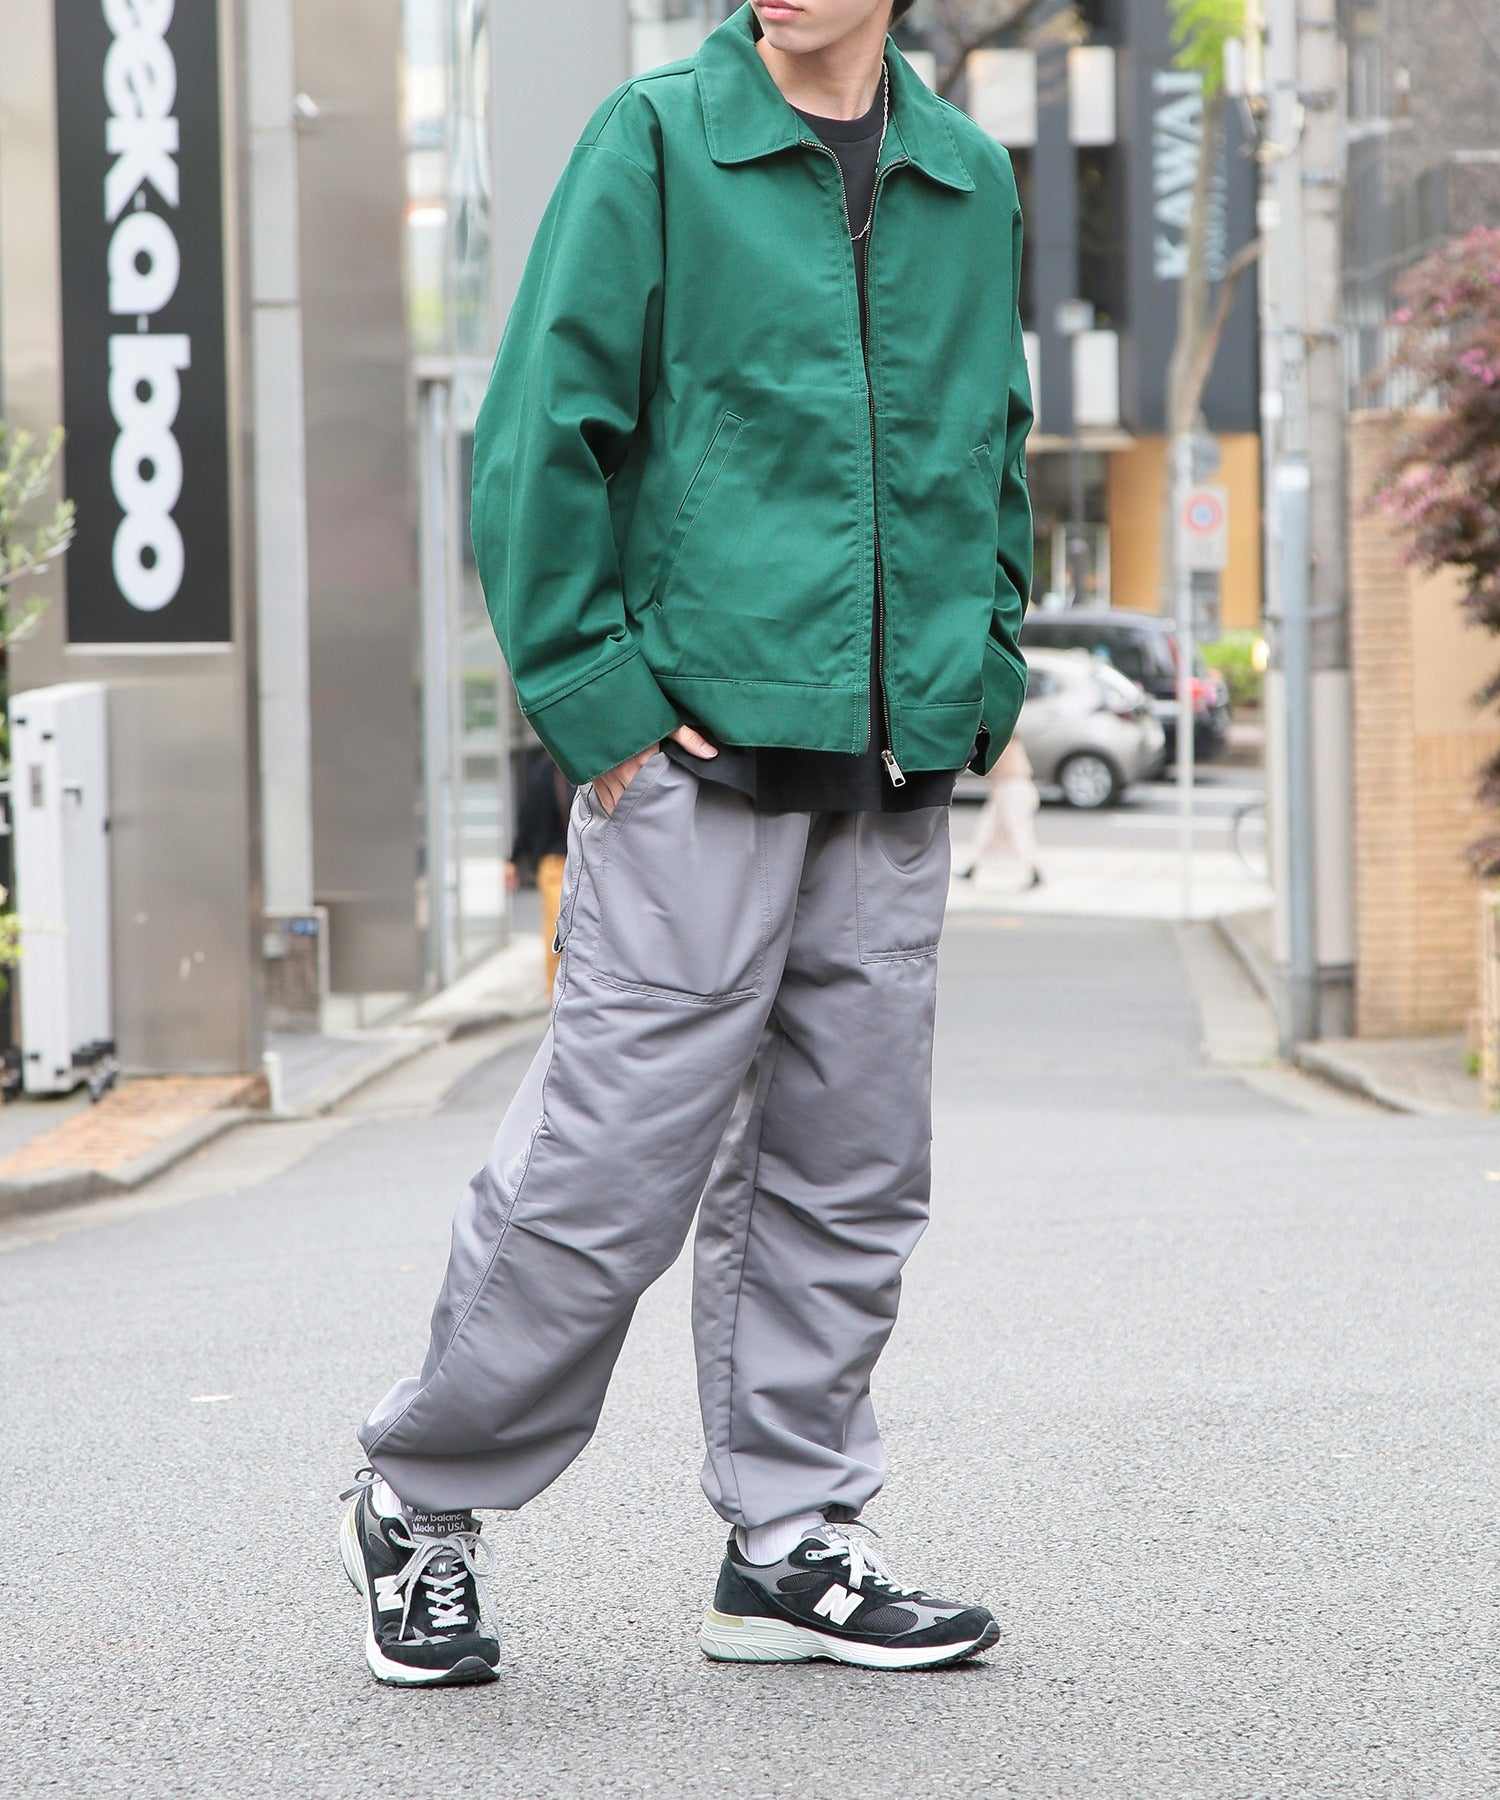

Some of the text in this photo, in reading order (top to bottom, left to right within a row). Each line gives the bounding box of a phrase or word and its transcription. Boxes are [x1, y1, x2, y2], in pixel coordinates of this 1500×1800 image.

[1153, 73, 1203, 280] KAWAI
[412, 1521, 465, 1533] Made in USA
[438, 1562, 447, 1572] N
[813, 1583, 864, 1626] N
